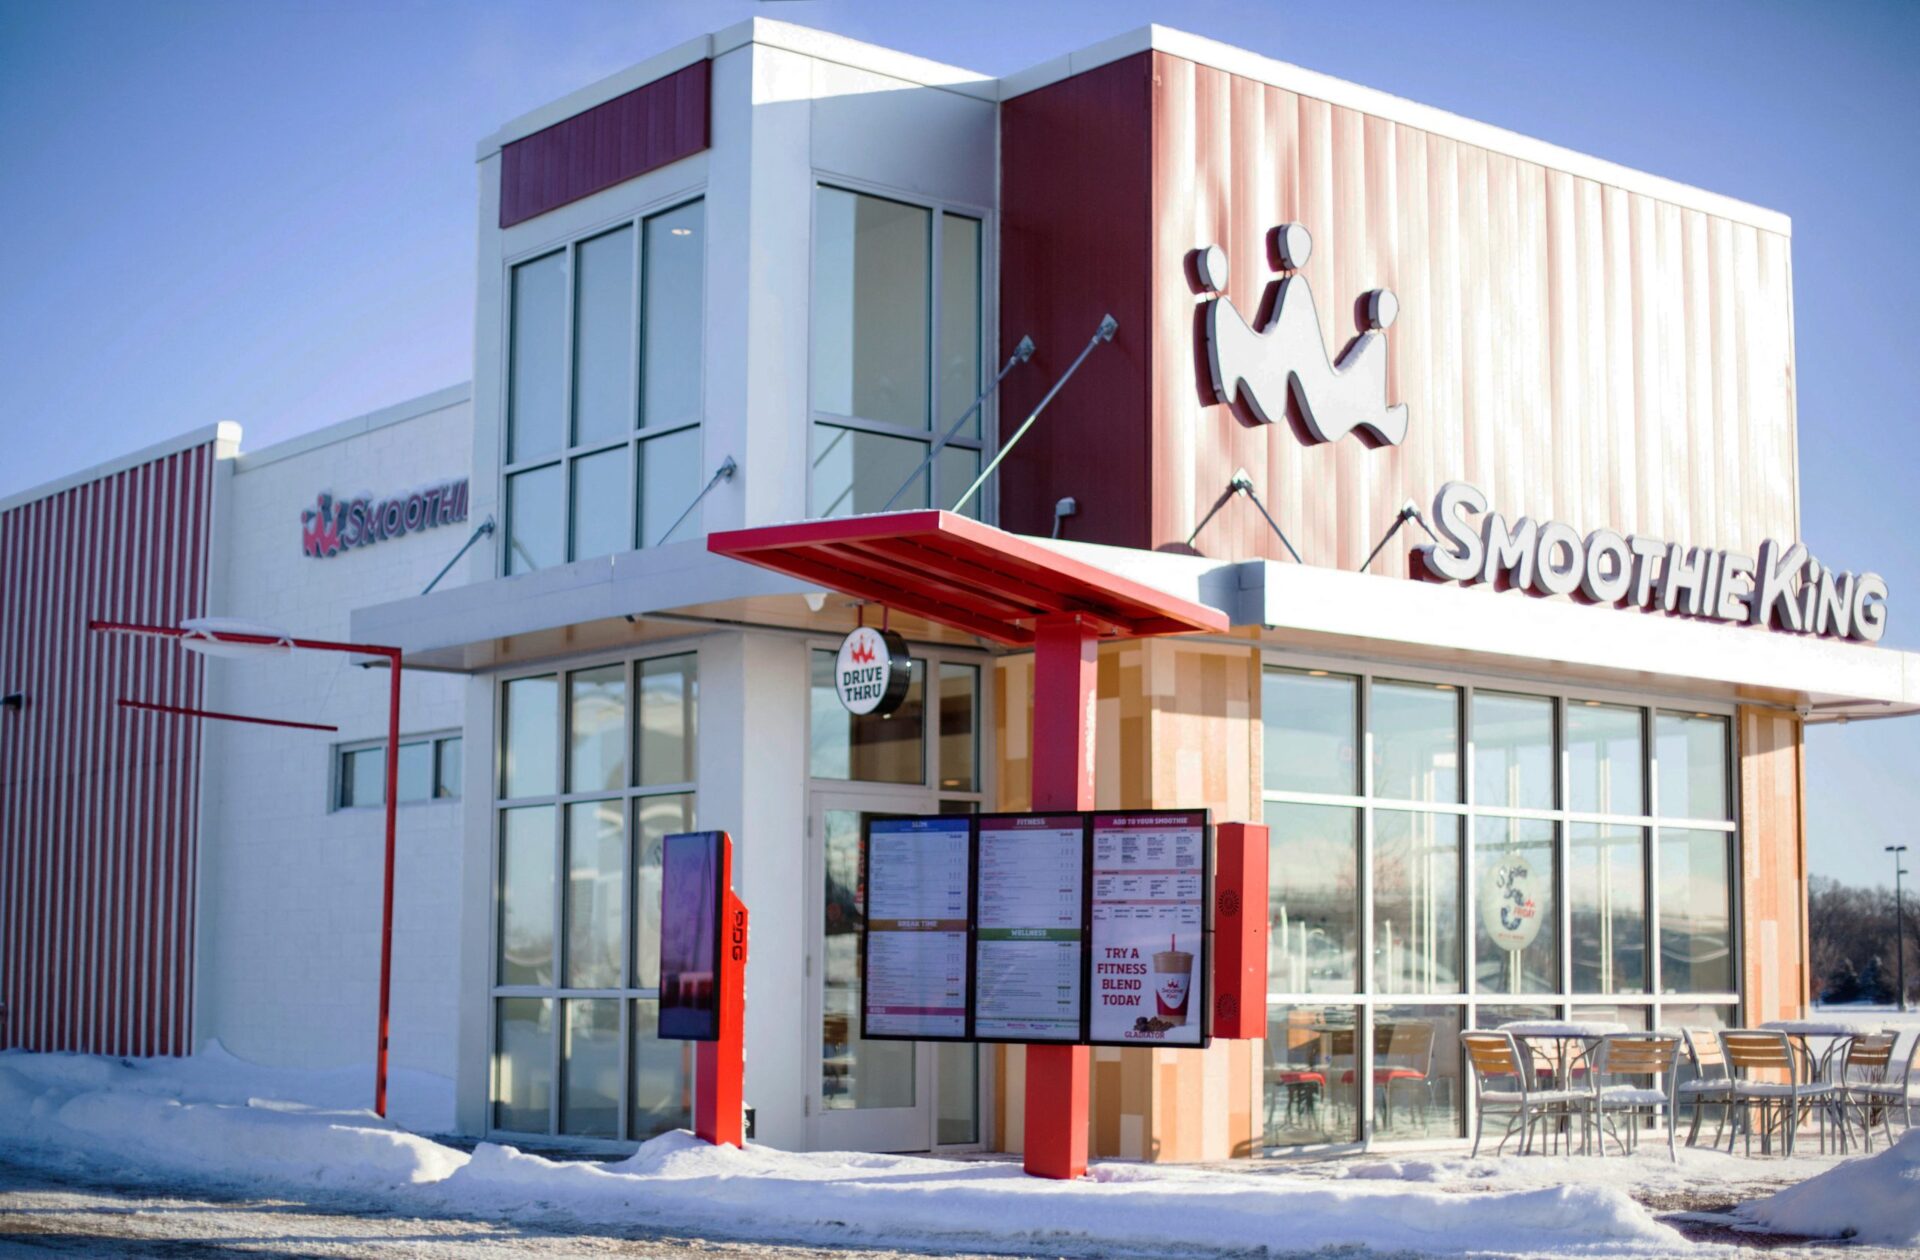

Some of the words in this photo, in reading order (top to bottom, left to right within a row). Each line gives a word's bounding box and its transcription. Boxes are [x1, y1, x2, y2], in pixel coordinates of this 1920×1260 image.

[343, 478, 468, 547] SMOOTHI
[1416, 481, 1754, 622] SMOOTHIE
[843, 666, 882, 686] DRIVE
[844, 683, 881, 702] THRU
[731, 911, 744, 961] PDG
[1105, 948, 1128, 958] TRY
[1130, 948, 1139, 958] A
[1097, 963, 1147, 974] FITNESS
[1102, 979, 1141, 990] BLEND
[1102, 994, 1141, 1005] TODAY
[1124, 1031, 1165, 1039] GLADIATOR
